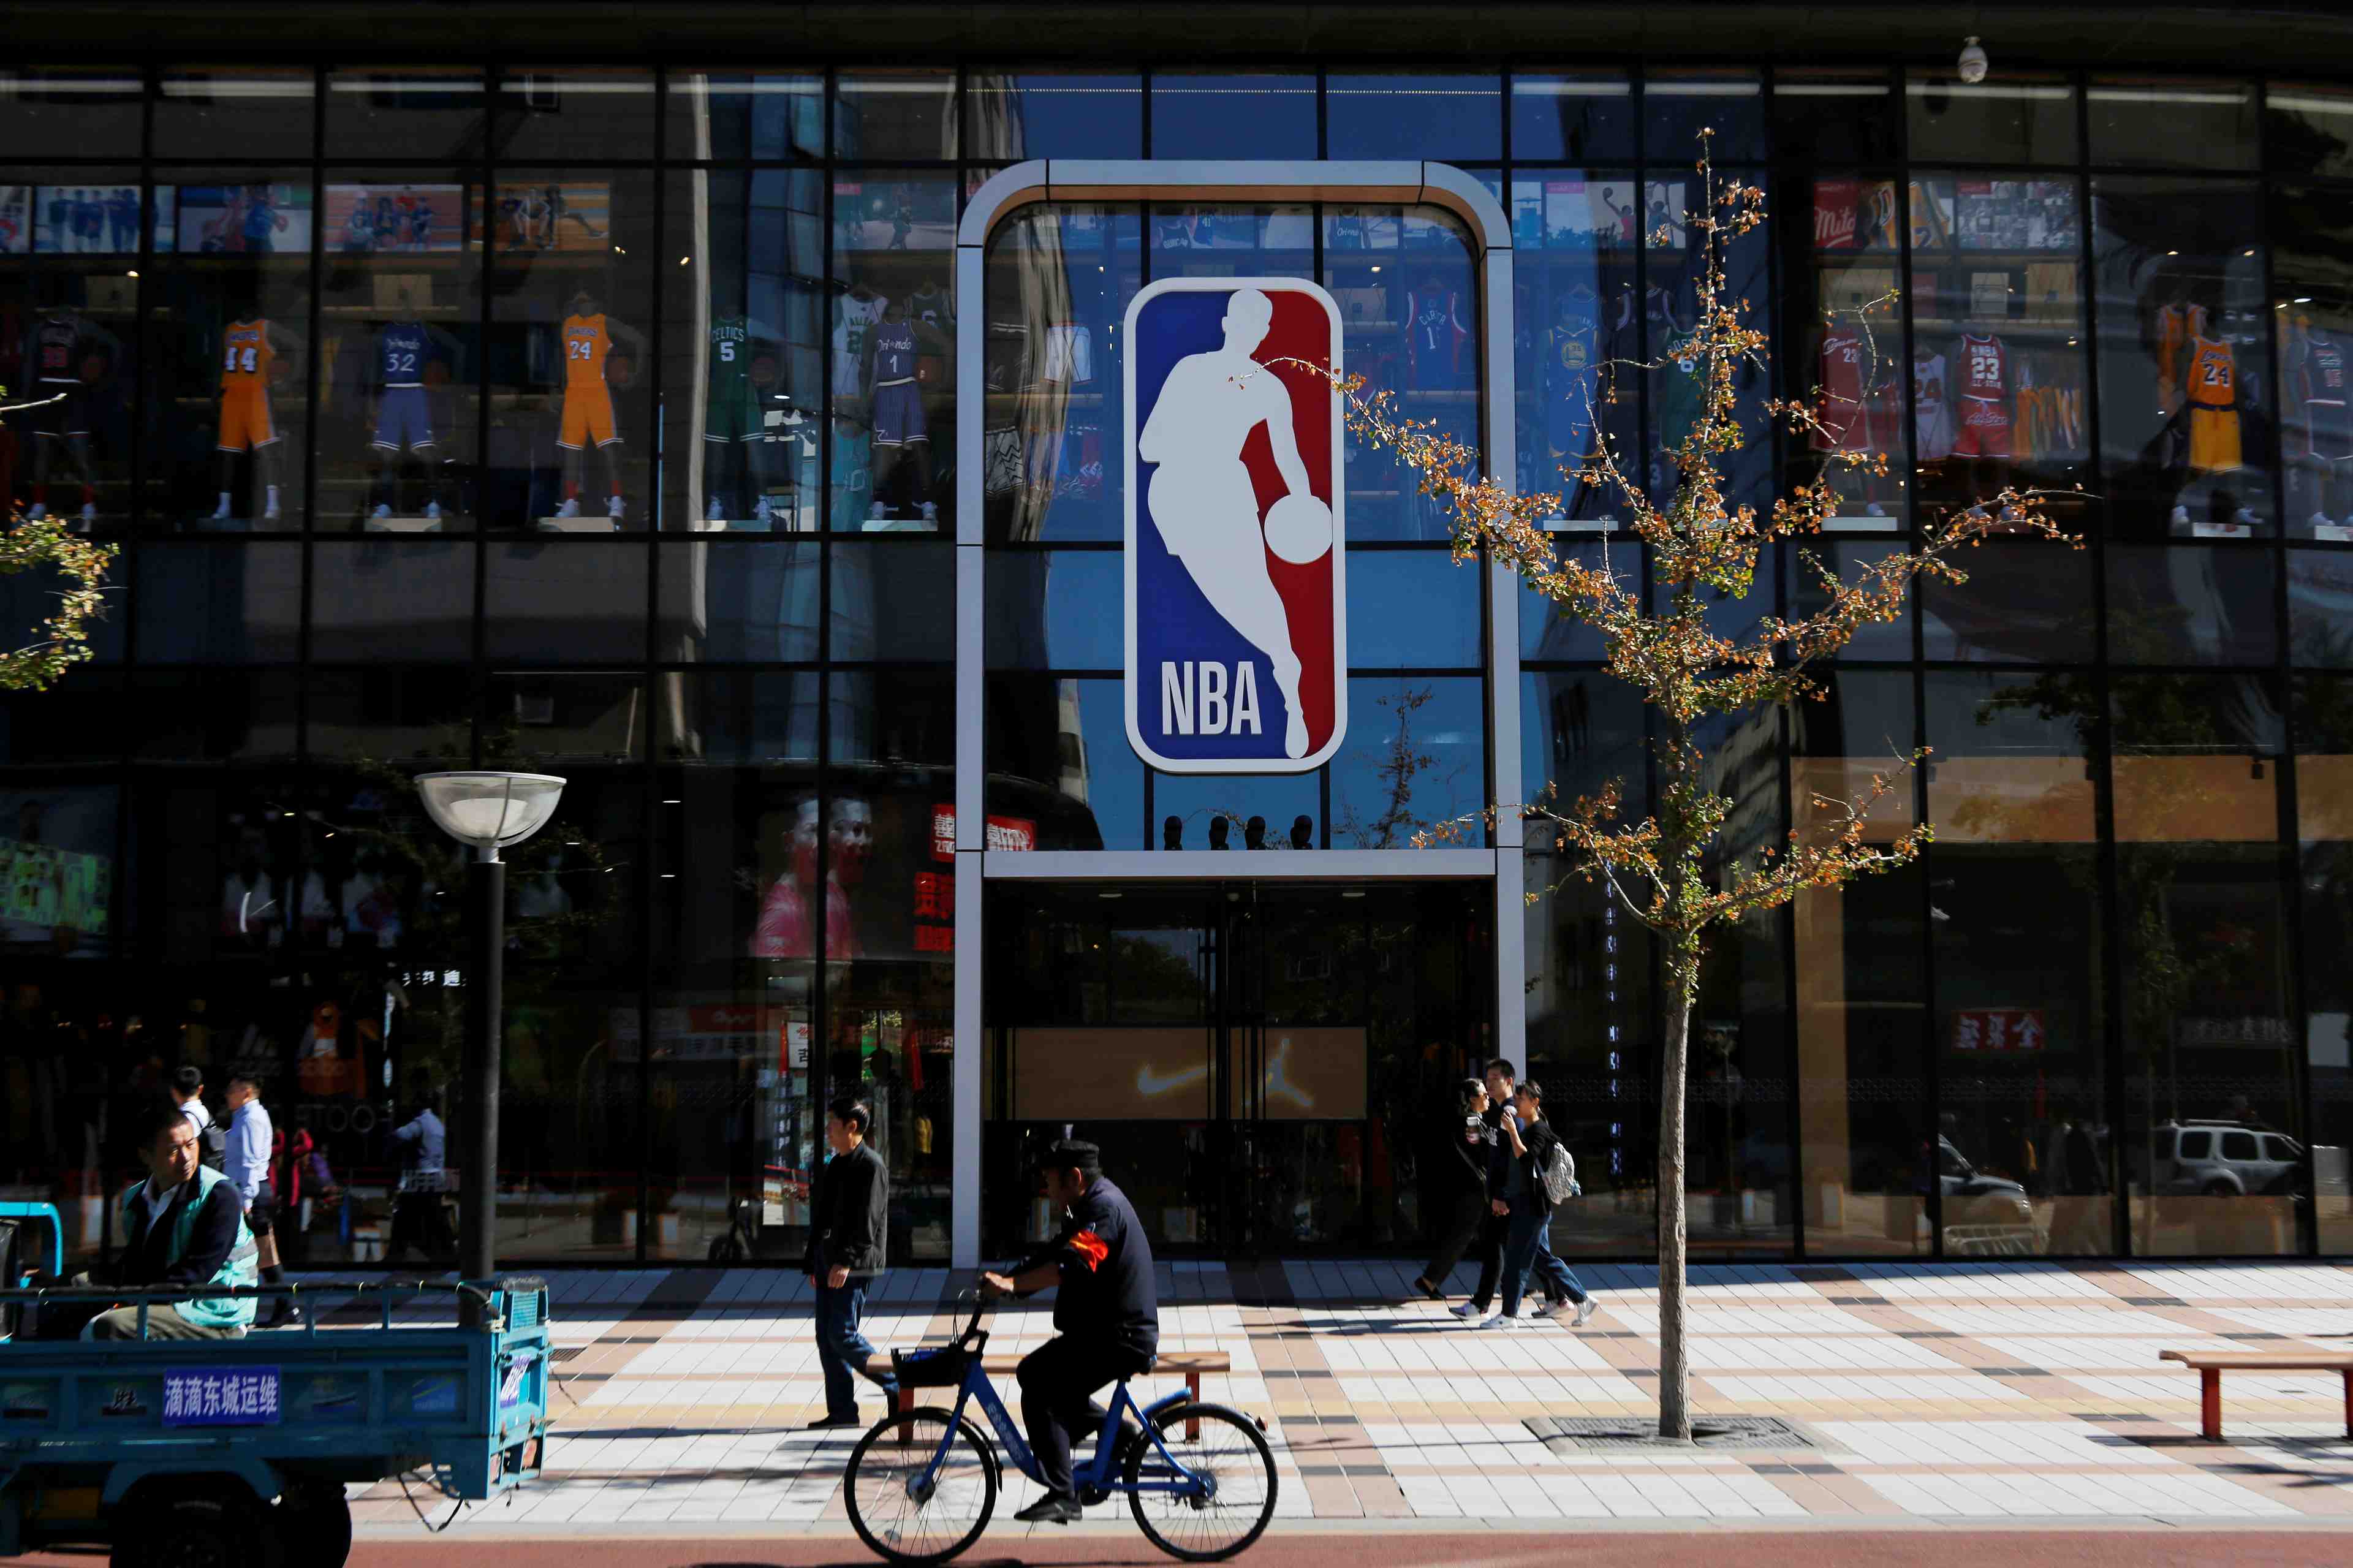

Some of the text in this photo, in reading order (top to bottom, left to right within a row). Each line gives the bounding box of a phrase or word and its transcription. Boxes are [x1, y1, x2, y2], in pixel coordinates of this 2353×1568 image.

[711, 326, 745, 343] CELTICS
[568, 340, 593, 360] 24
[720, 341, 735, 362] 5
[386, 354, 417, 372] 32
[889, 355, 898, 373] 1
[1971, 357, 2000, 381] 23
[2202, 363, 2231, 388] 24
[1162, 661, 1262, 735] NBA
[164, 1375, 278, 1417] 滴滴东城运维
